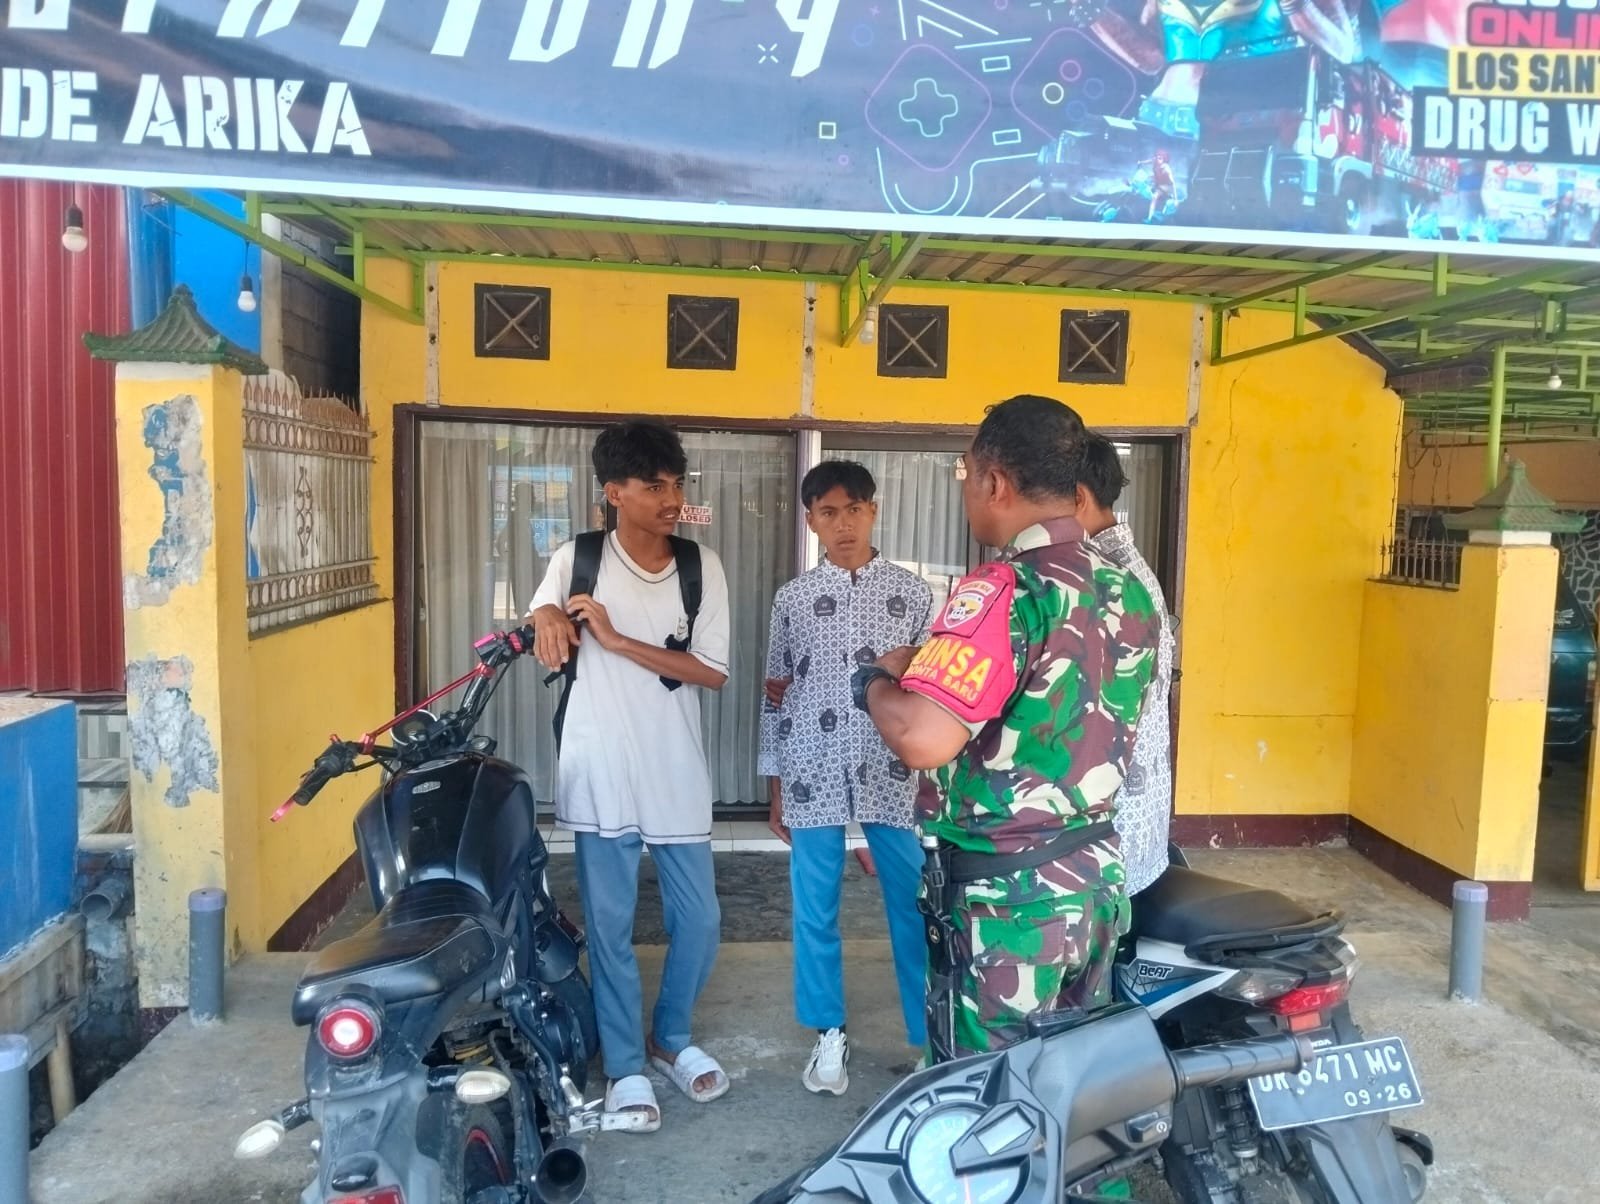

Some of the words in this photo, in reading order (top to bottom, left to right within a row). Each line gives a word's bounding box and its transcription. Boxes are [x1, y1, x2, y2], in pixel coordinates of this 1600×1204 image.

[1470, 6, 1600, 50] ONLI
[1457, 51, 1519, 91] LOS
[1529, 54, 1600, 93] SAN
[1, 67, 97, 142] DE
[122, 73, 372, 156] ARIKA
[1424, 96, 1549, 153] DRUG
[680, 515, 711, 523] LOSED
[683, 506, 709, 514] UTUP
[943, 675, 978, 702] BARU
[1364, 1045, 1402, 1075] MC
